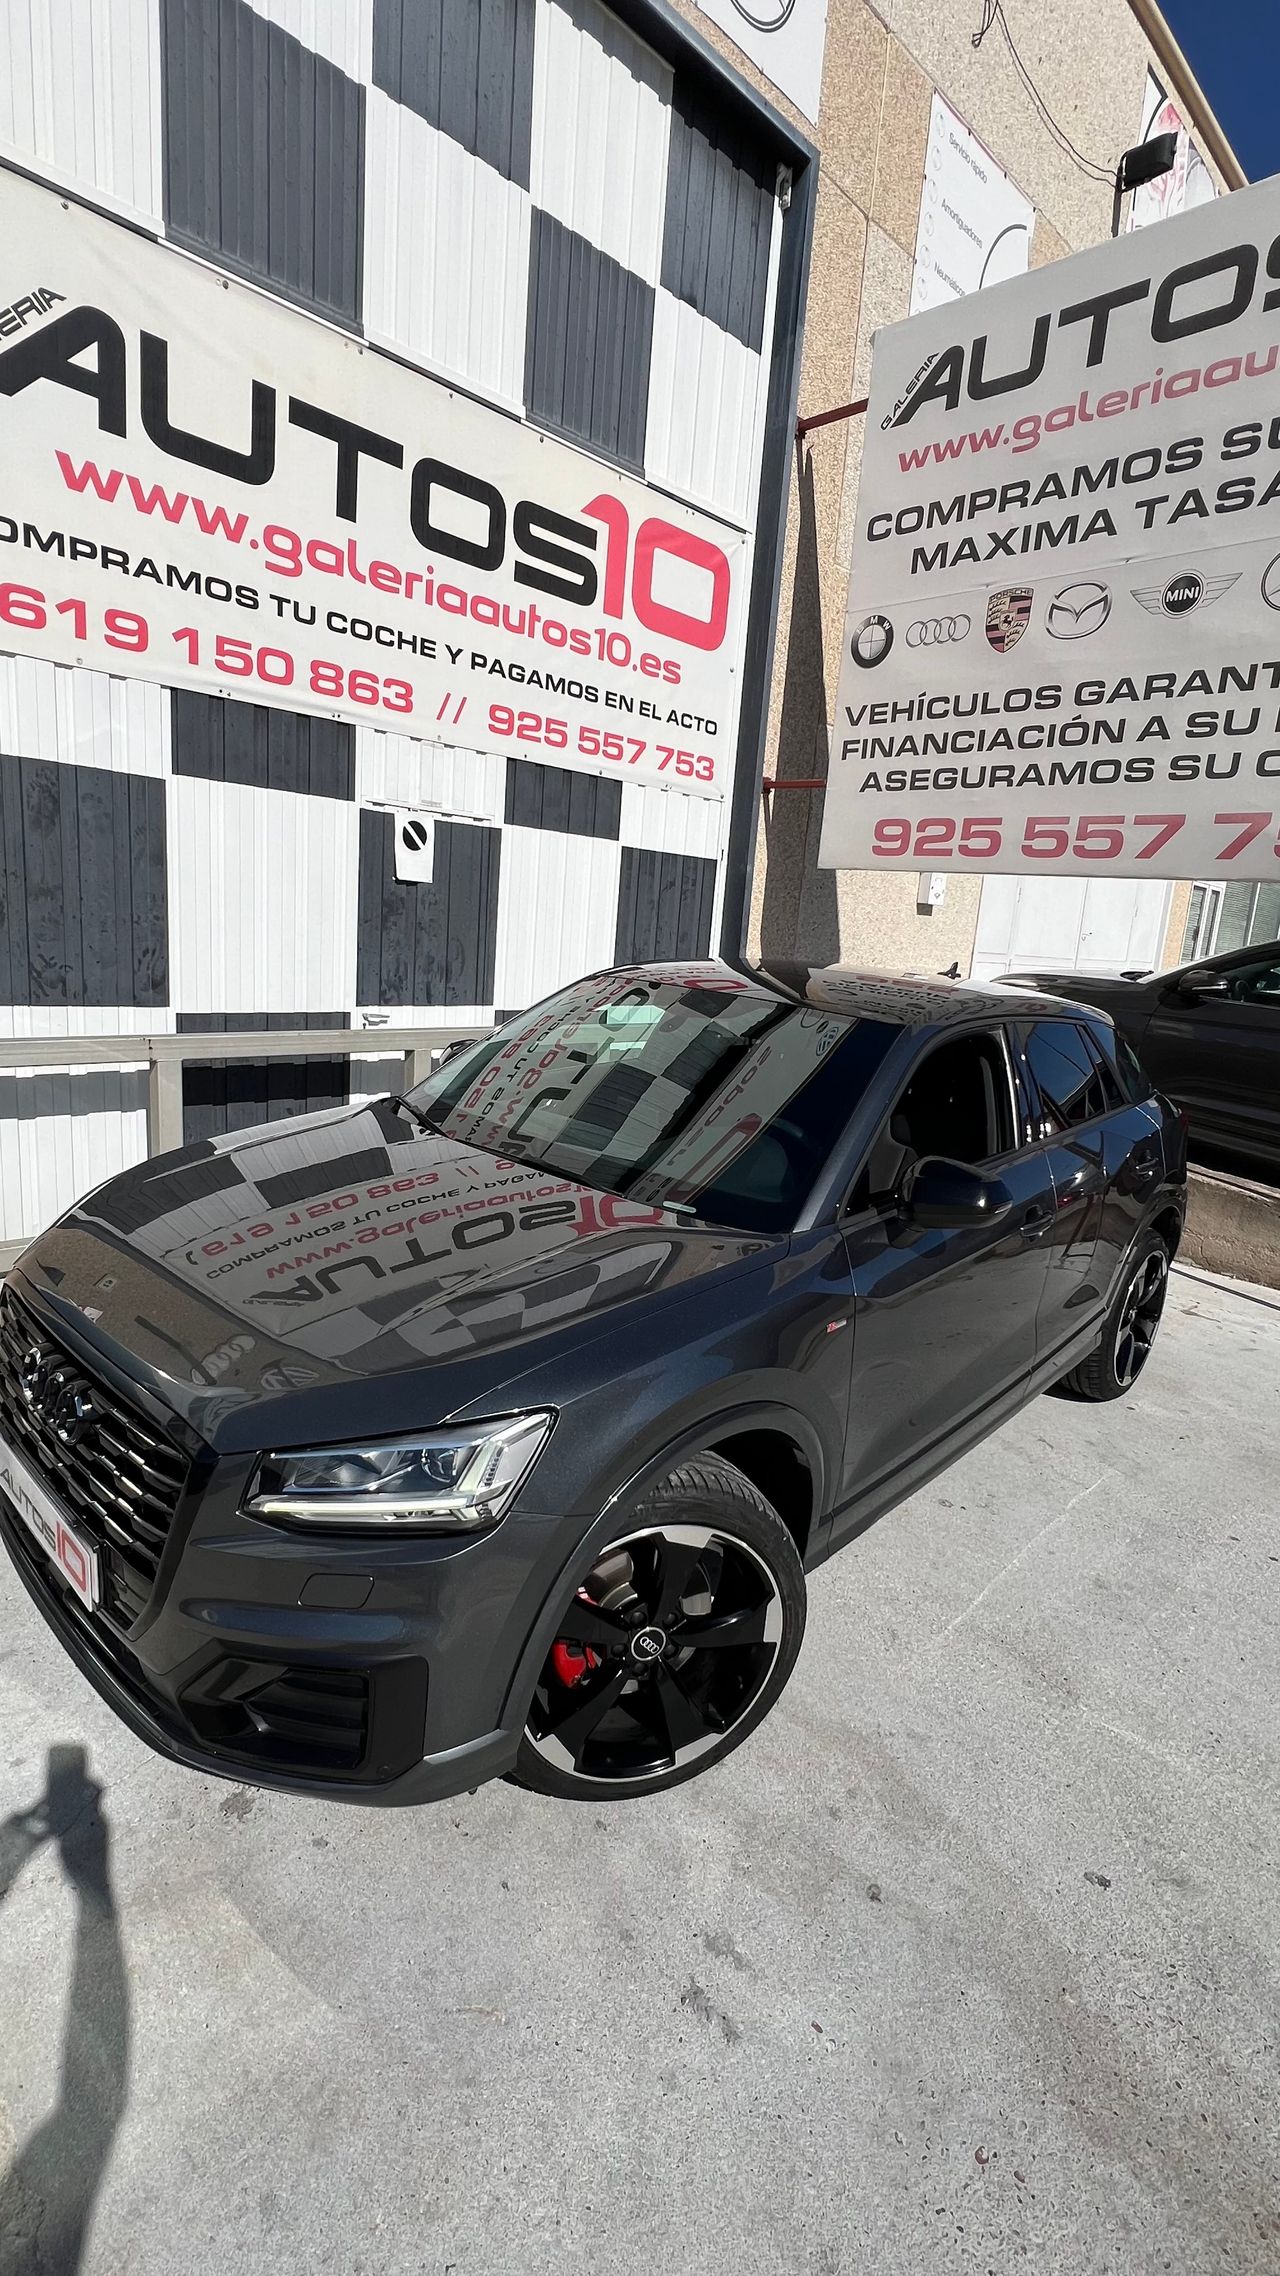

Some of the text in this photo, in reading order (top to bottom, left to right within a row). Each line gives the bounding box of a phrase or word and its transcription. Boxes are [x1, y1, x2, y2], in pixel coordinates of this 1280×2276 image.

[890, 233, 1280, 429] AUTO
[880, 352, 939, 430] GALERIA
[866, 416, 1280, 541] COMPRAMOS S
[55, 449, 682, 685] www.galeriaautos10.es
[910, 508, 1118, 574] MAXIMA
[1165, 586, 1200, 602] MINI
[0, 582, 148, 653] 619
[172, 627, 294, 686] 150
[309, 659, 413, 713] 863
[488, 704, 568, 748] 925
[578, 725, 647, 764] 557
[655, 745, 714, 781] 753
[269, 593, 317, 625] TU
[327, 611, 437, 659] COCHE
[444, 644, 464, 665] Y
[471, 650, 599, 703] PAGAMOS
[604, 690, 634, 713] EN
[639, 701, 662, 721] EL
[665, 709, 718, 735] ACTO
[841, 715, 1126, 761] FINANCIACIÓN
[1136, 715, 1171, 742] A
[1185, 707, 1261, 739] SU
[844, 684, 1061, 727] VEHÍCULOS
[859, 757, 1156, 793] ASEGURAMOS
[1168, 752, 1242, 781] SU
[871, 812, 1280, 860] 925 557 7
